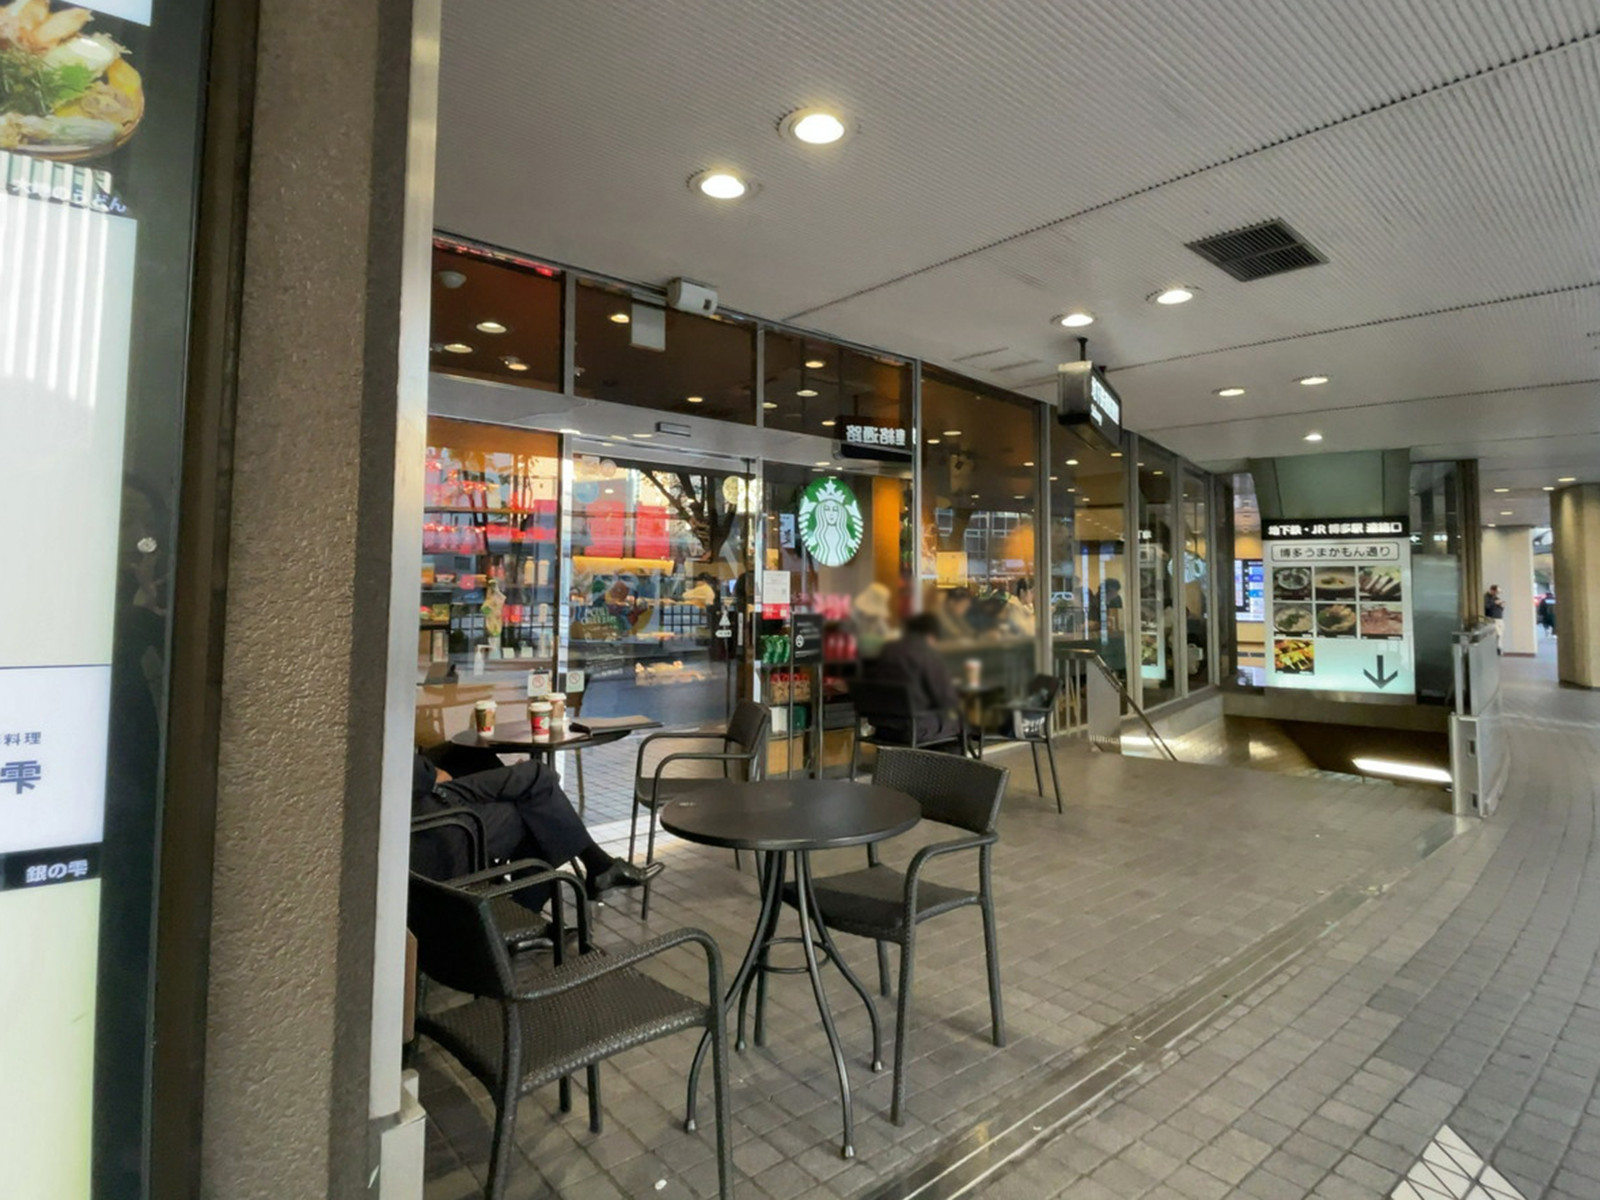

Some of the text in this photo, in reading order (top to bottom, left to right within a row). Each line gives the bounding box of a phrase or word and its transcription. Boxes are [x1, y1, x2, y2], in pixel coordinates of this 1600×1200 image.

[1280, 546, 1391, 558] 博多うまかもん通り
[0, 760, 42, 795] 雫
[25, 860, 89, 883] 銀の雫
